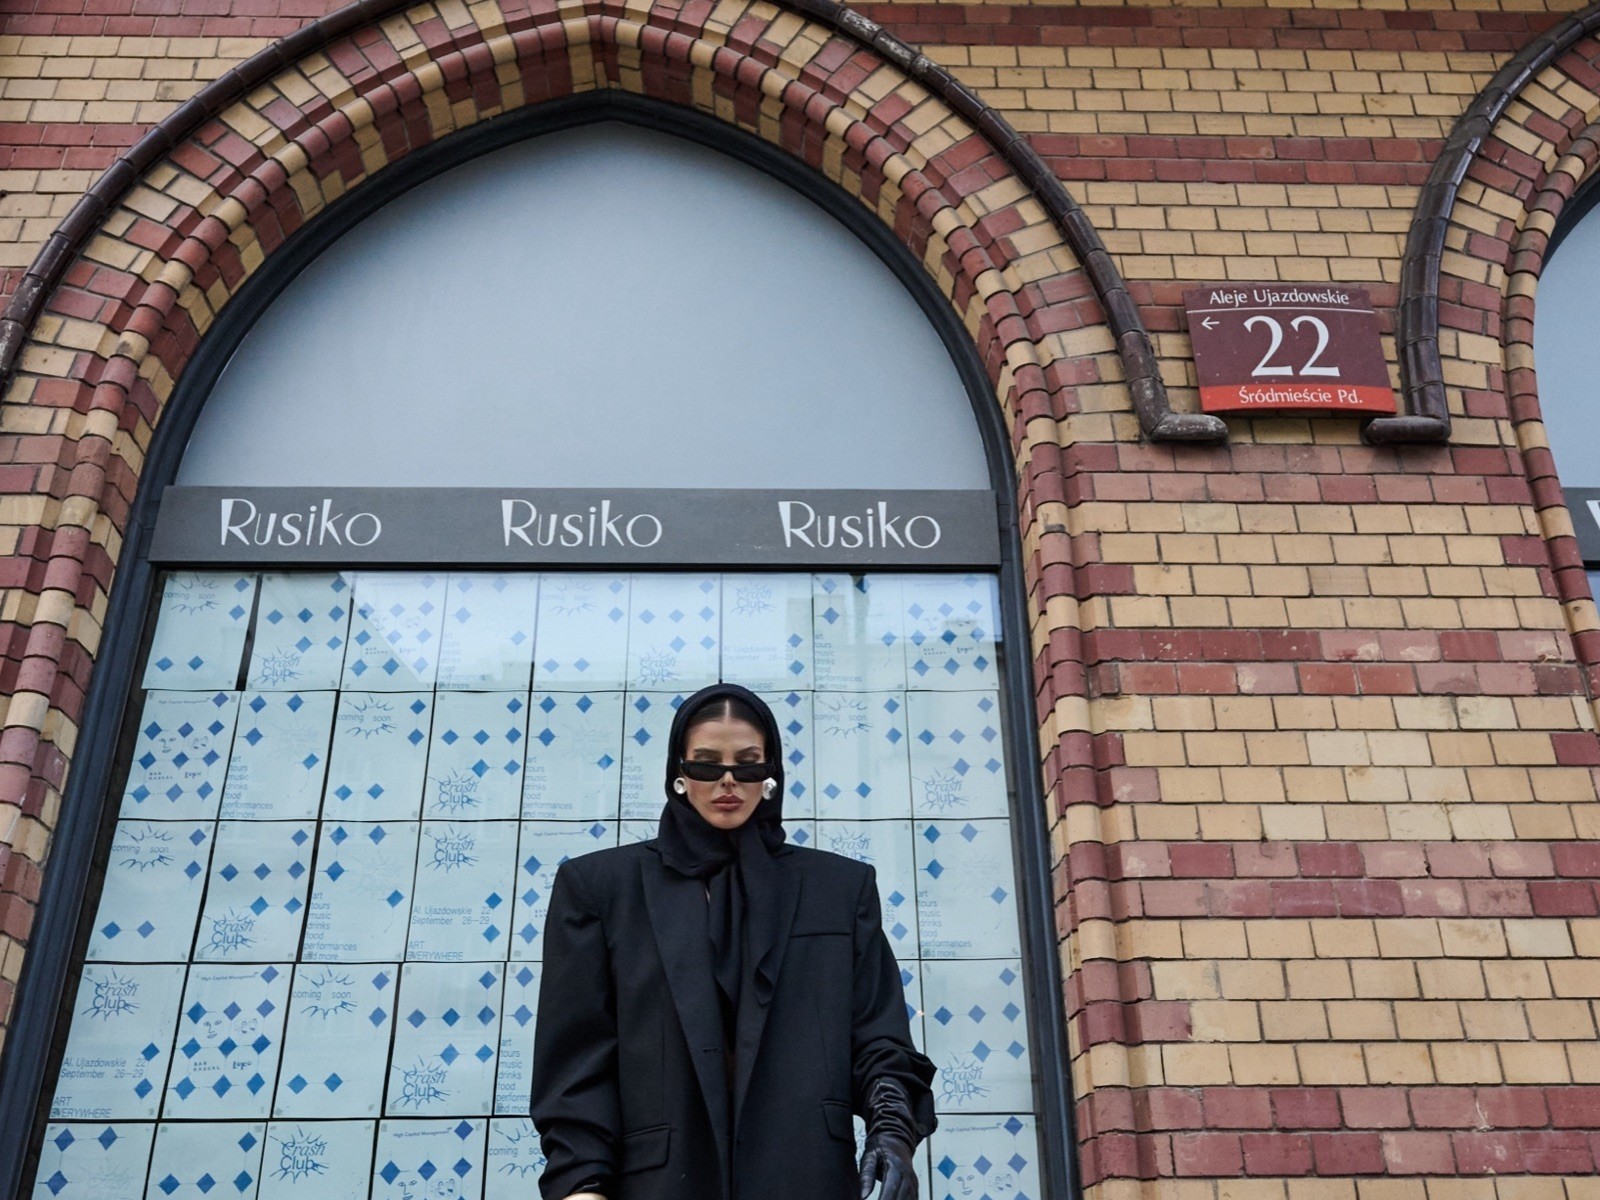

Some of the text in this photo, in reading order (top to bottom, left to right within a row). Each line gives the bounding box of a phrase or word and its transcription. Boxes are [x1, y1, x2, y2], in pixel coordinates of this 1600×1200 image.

[1209, 288, 1350, 307] Aleje Ujazdowskie
[1243, 315, 1341, 377] 22
[1238, 386, 1363, 404] Śródmieście Pd.
[220, 498, 382, 547] Rusiko
[501, 499, 663, 548] Rusiko
[777, 500, 942, 550] Rusiko
[438, 791, 471, 804] Club
[111, 844, 170, 854] coming soon
[433, 849, 466, 863] Club
[312, 891, 324, 900] art
[311, 901, 331, 910] tours
[413, 906, 424, 914] Al.
[425, 906, 473, 916] Ujazdowskie
[309, 912, 332, 920] music
[411, 916, 454, 926] September
[307, 921, 331, 930] drinks
[211, 931, 244, 945] Club
[306, 931, 324, 940] food
[304, 941, 358, 952] performances
[94, 983, 138, 997] Crash
[292, 990, 352, 1001] coming soon
[92, 995, 126, 1010] Club
[63, 1058, 147, 1070] Al. Ujazdowskie 22
[60, 1069, 105, 1081] September
[403, 1070, 446, 1084] Crash
[402, 1083, 436, 1099] Club
[941, 1079, 975, 1095] Club
[53, 1096, 72, 1106] ART
[512, 1105, 529, 1114] mor
[281, 1140, 327, 1157] Crash
[488, 1146, 519, 1159] coming
[279, 1155, 316, 1172] Club
